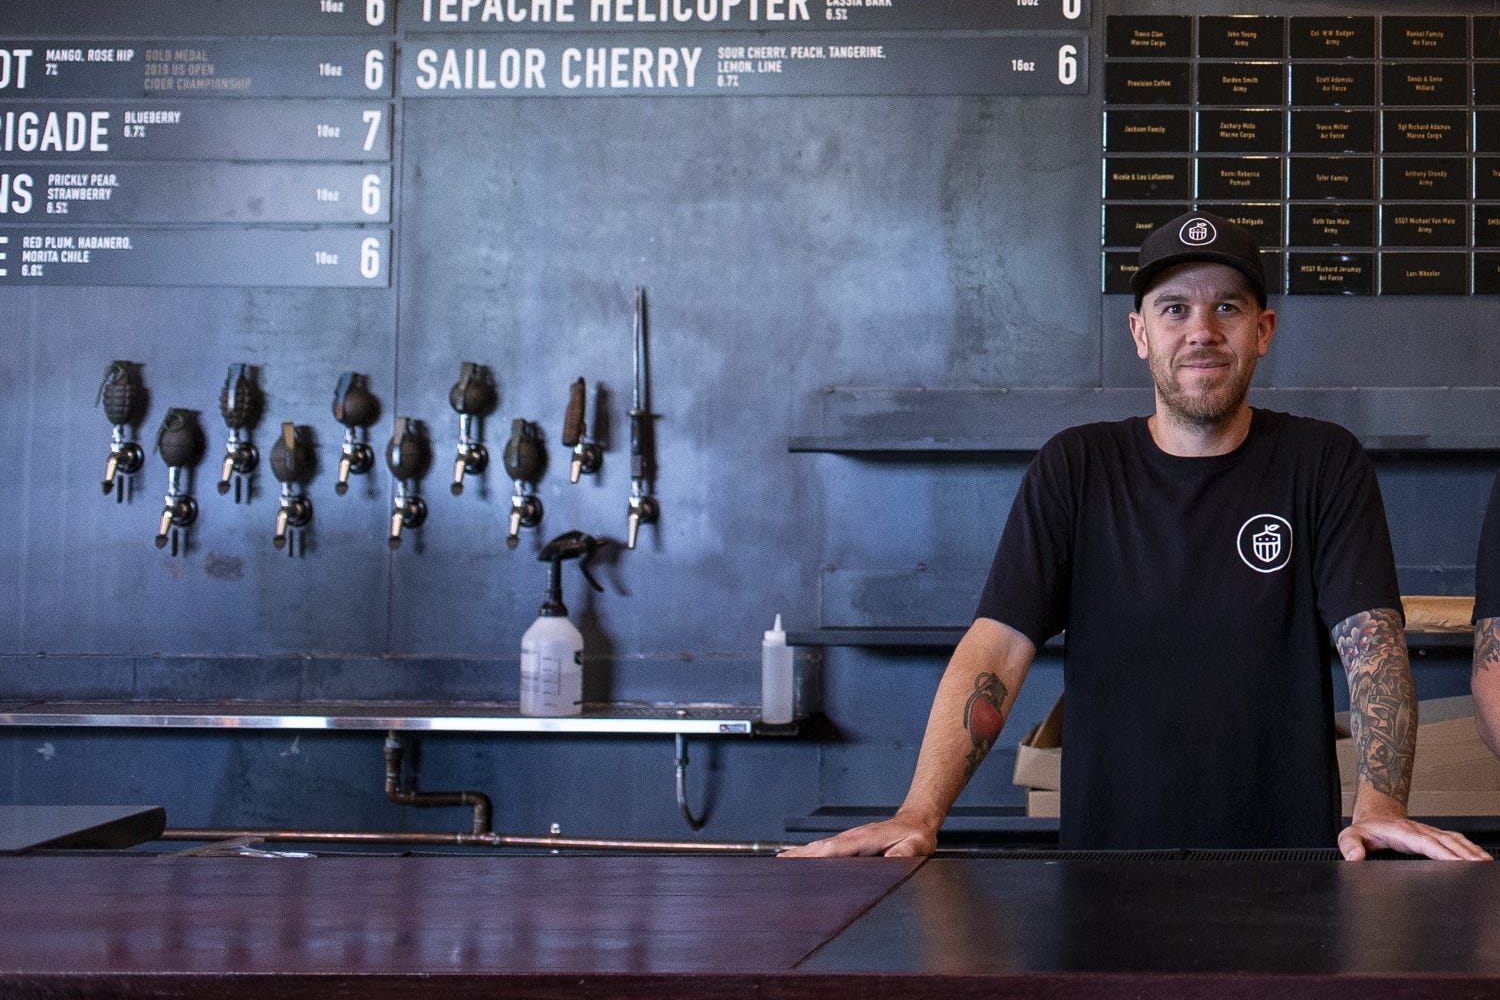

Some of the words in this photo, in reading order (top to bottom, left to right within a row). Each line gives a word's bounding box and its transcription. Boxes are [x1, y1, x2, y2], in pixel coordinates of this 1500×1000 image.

[320, 0, 344, 13] 16oz
[826, 8, 848, 21] 6.5%
[87, 49, 114, 62] ROSE
[116, 49, 134, 62] HIP
[174, 50, 208, 61] MEDAL
[718, 47, 746, 59] SOUR
[188, 64, 214, 76] OPEN
[319, 63, 343, 77] 16oz
[364, 49, 384, 90] 6
[415, 48, 547, 90] SAILOR
[560, 47, 703, 89] CHERRY
[758, 61, 782, 73] LIME
[1012, 59, 1035, 71] 16oz
[1058, 45, 1077, 85] 6
[144, 78, 173, 90] CIDER
[176, 78, 251, 90] CHAMPIONSHIP
[124, 111, 181, 124] BLUEBERRY
[0, 111, 110, 151] IGADE
[362, 110, 381, 151] 7
[48, 174, 88, 187] PRICKLY
[47, 188, 112, 201] STRAWBERRY
[361, 173, 381, 215] 6
[23, 236, 42, 249] RED
[22, 250, 59, 263] MORITA
[60, 250, 90, 263] CHILE
[360, 237, 380, 279] 6
